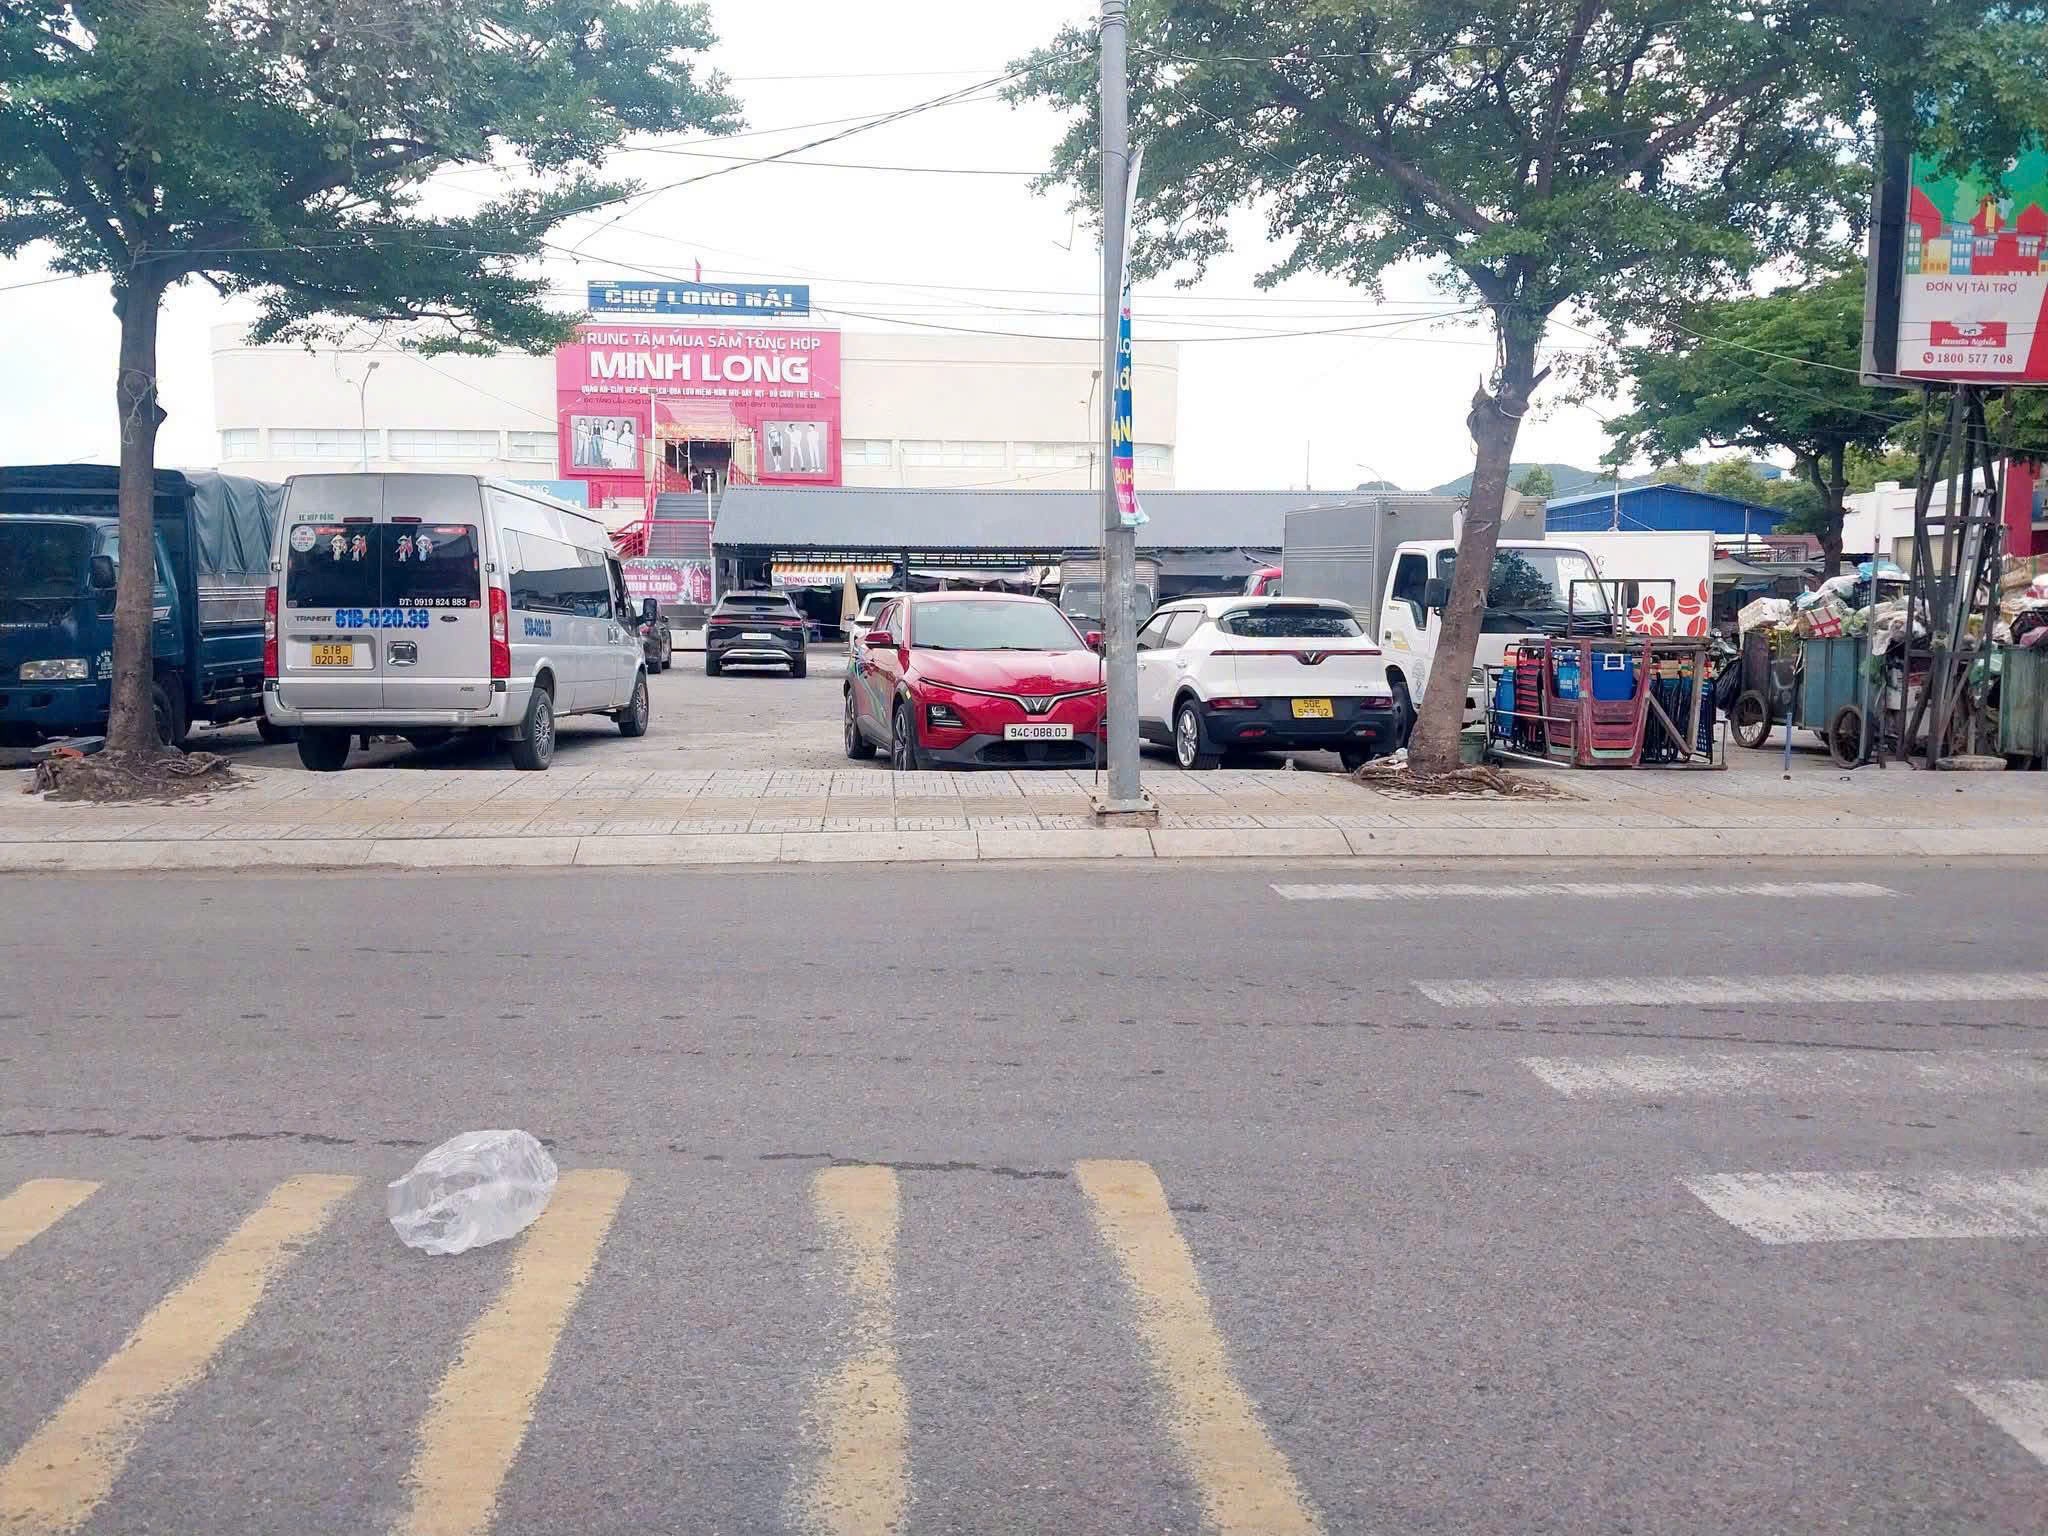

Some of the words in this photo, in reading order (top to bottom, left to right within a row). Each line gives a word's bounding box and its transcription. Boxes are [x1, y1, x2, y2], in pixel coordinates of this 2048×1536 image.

[1926, 281, 1953, 292] ĐƠN
[1956, 282, 1968, 294] VỊ
[1971, 281, 1990, 293] TÀI
[1992, 282, 2018, 295] TRỢ
[605, 288, 660, 307] CHỢ
[666, 290, 738, 307] LONG
[632, 330, 665, 346] TÂM
[669, 334, 704, 347] MUA
[790, 336, 821, 352] HỢP
[1937, 352, 1964, 364] 1800
[1967, 353, 1989, 364] 577
[1992, 354, 2014, 365] 708
[590, 351, 691, 381] MINH
[701, 354, 809, 384] LONG
[414, 598, 434, 606] 0919
[335, 608, 430, 630] 61B-020.38
[322, 645, 342, 655] 61B
[315, 655, 349, 665] 020.38
[1010, 727, 1068, 738] 94C-088.03
